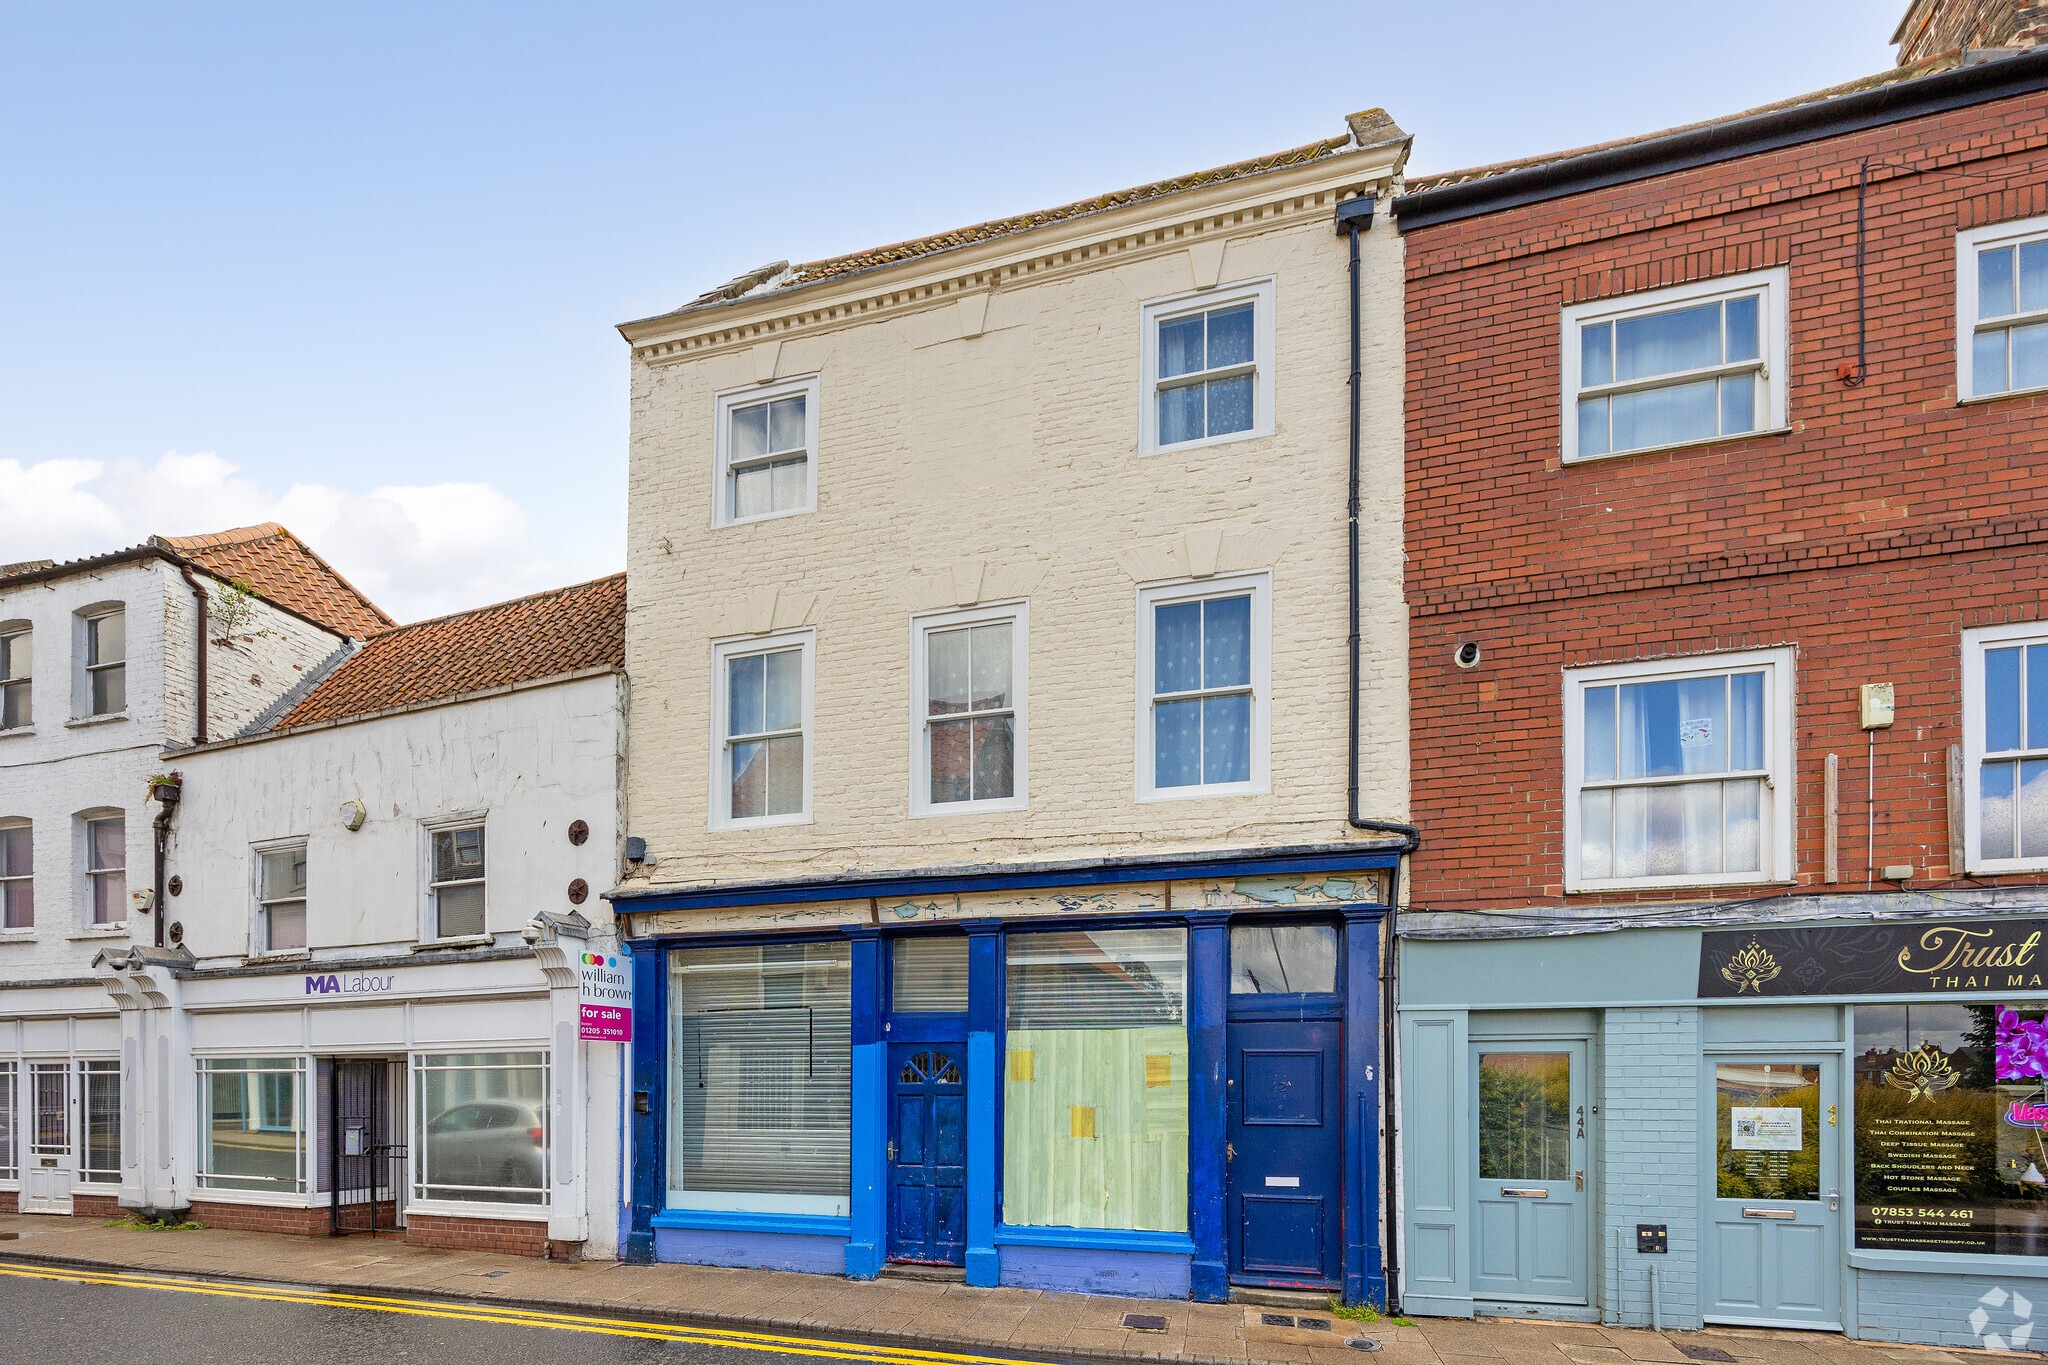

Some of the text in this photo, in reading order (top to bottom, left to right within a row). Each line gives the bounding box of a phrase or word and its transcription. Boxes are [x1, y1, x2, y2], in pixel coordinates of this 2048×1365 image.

[1898, 926, 2042, 973] Trust
[306, 972, 394, 994] MA Labour
[582, 968, 624, 984] william
[1930, 974, 2042, 988] THAI MA
[582, 982, 632, 1000] h brown
[581, 1007, 622, 1020] for sale
[581, 1026, 623, 1036] 01205 351010
[1576, 1105, 1585, 1140] 44A
[1872, 1207, 1974, 1219] 07853 544 461
